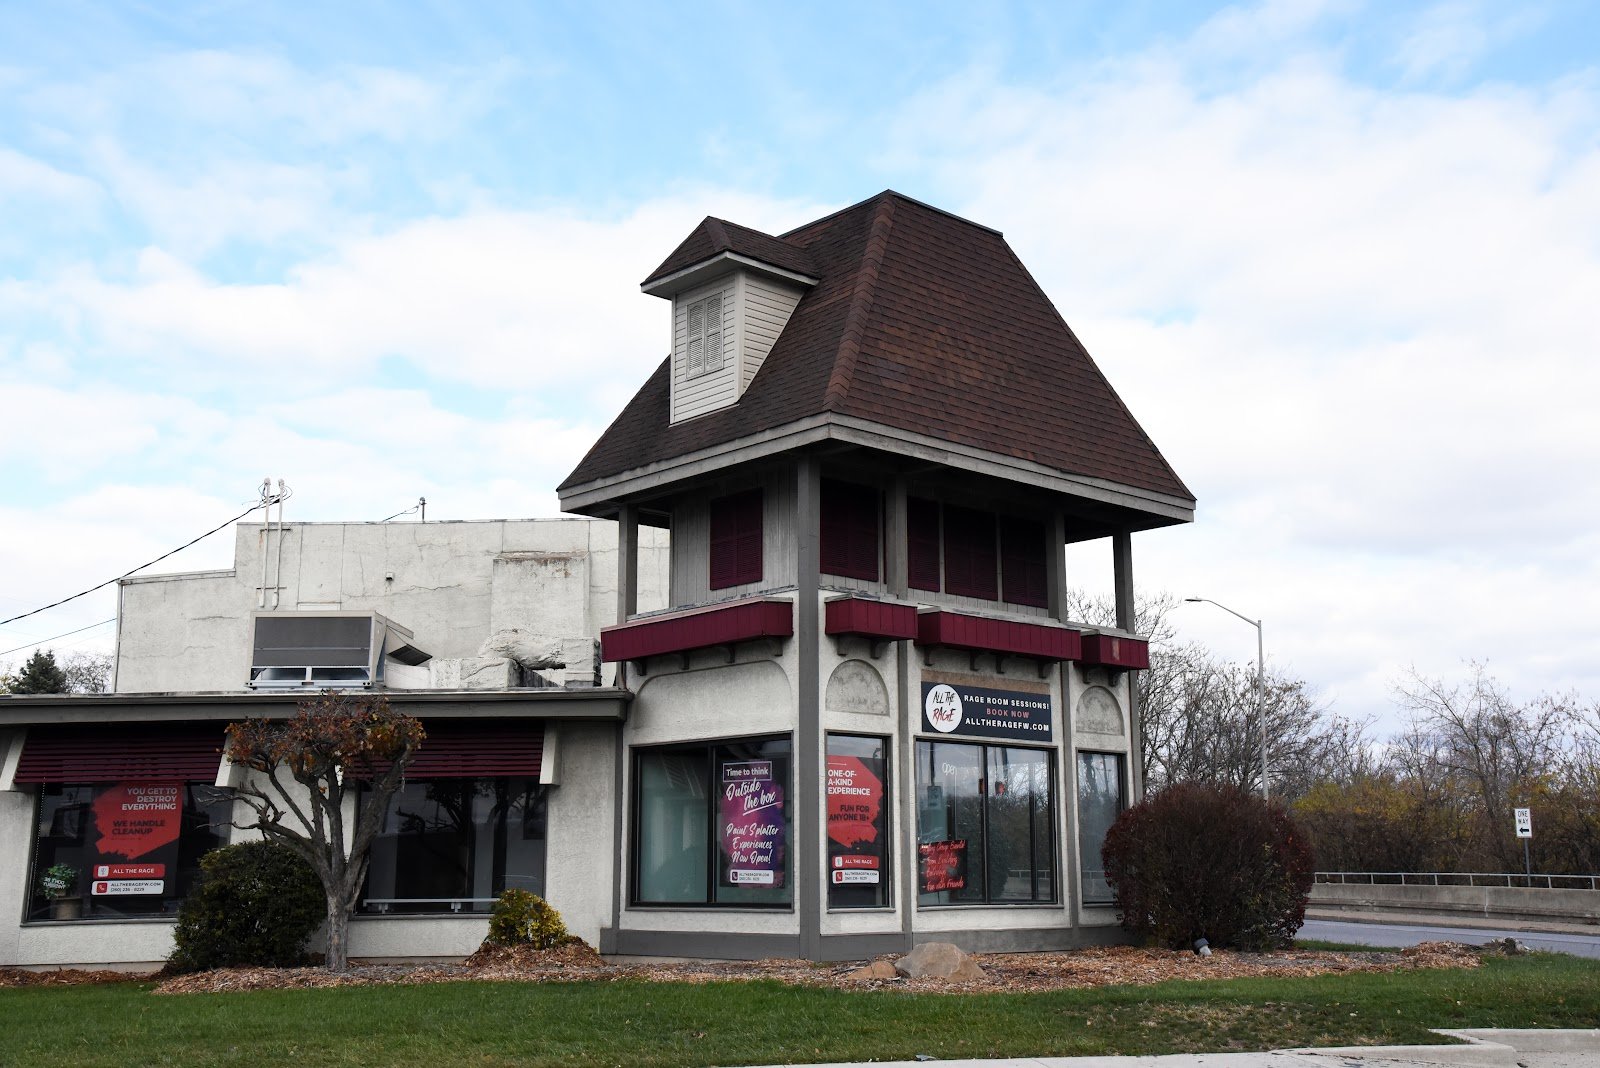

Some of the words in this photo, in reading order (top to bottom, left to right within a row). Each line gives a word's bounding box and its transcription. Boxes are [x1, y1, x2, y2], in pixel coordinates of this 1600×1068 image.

[932, 690, 944, 704] ALL
[945, 691, 955, 706] THE
[964, 694, 984, 703] RAGE
[986, 697, 1009, 706] ROOM
[1011, 699, 1050, 710] SESSIONS!
[932, 707, 956, 725] RAGE
[986, 708, 1008, 717] BOOK
[1011, 710, 1030, 719] NOW
[965, 717, 1050, 732] ALLTHERAGEFW.COM
[726, 768, 742, 777] Time
[743, 767, 750, 776] to
[751, 766, 769, 776] think
[828, 769, 857, 777] ONE-OF-
[828, 778, 853, 786] A-KIND
[127, 787, 145, 795] YOU
[148, 787, 163, 795] GET
[165, 787, 178, 795] TO
[726, 777, 761, 801] Outside
[828, 787, 871, 796] EXPERIENCE
[137, 795, 177, 803] DESTROY
[743, 795, 759, 811] the
[760, 789, 776, 805] box
[122, 803, 177, 811] EVERYTHING
[840, 804, 855, 812] FUN
[829, 813, 858, 821] ANYONE
[1517, 810, 1528, 818] ONE
[129, 819, 165, 827] HANDLE
[112, 828, 153, 836] CLEANUP
[726, 823, 748, 837] Paint
[749, 822, 779, 837] Splatter
[732, 836, 773, 851] Experiences
[731, 851, 748, 863] Now
[750, 849, 772, 865] Open!
